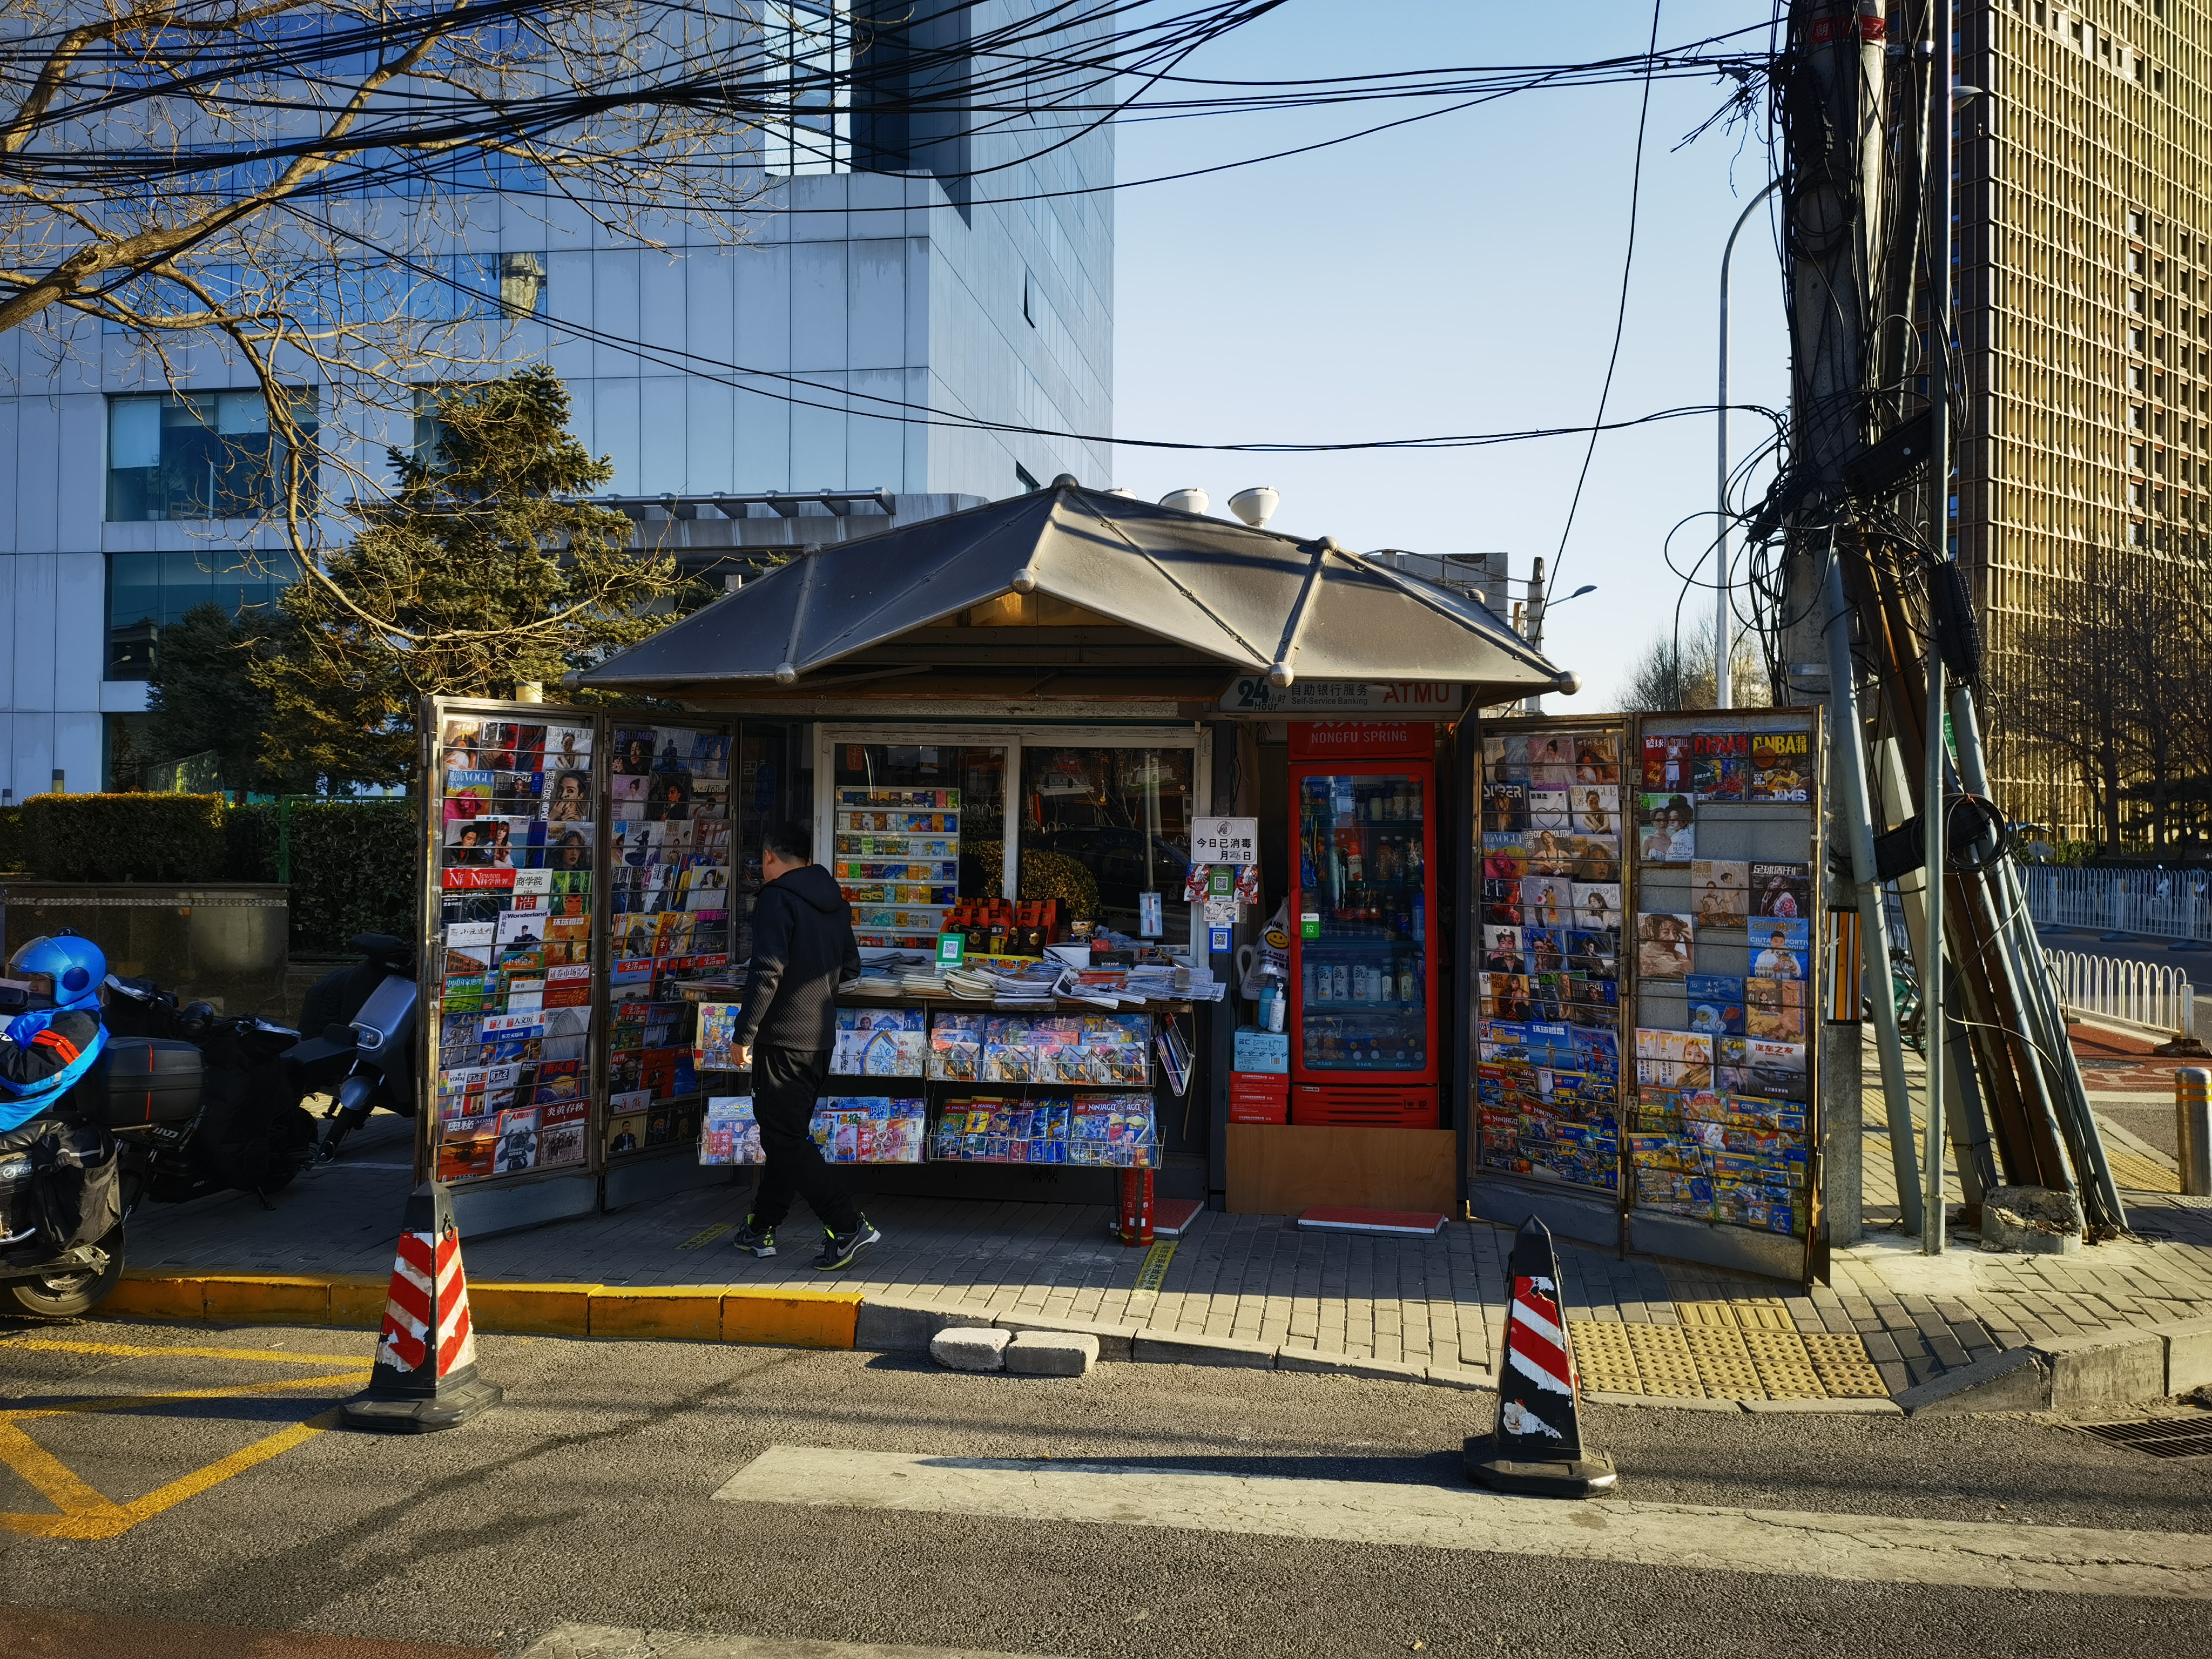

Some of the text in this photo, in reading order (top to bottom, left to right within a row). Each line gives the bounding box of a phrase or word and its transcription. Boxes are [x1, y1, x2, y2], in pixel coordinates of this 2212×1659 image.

[1237, 680, 1286, 707] 24 小时
[1292, 684, 1368, 697] 自助银行服务
[1254, 702, 1278, 711] Hour
[1291, 697, 1368, 706] Self-Service Banking
[1311, 731, 1407, 744] NONGFU SPRING
[1645, 739, 1664, 748] 篮球
[1765, 735, 1807, 754] NBA 特刊
[464, 771, 493, 782] VOGU
[1533, 830, 1573, 839] COSOPOLITAN
[1197, 838, 1252, 849] 今日已消毒
[1220, 851, 1229, 860] 月
[1243, 851, 1251, 860] 日
[1752, 864, 1797, 875] 足球周刊
[470, 872, 501, 886] Newton
[516, 876, 543, 886] 商学院
[517, 896, 536, 911] 造
[507, 911, 549, 919] Wonderland.
[1305, 924, 1314, 933] 拉
[1755, 1043, 1794, 1055] 汽车之友
[544, 1062, 576, 1075] 南风窗
[467, 1073, 482, 1082] 财经
[489, 1069, 509, 1081] 财经
[547, 1102, 585, 1117] 炎黄春秋
[1087, 1103, 1117, 1112] NINJAGO
[1492, 1115, 1519, 1124] NINJAGO
[447, 1120, 474, 1132] 奥秘
